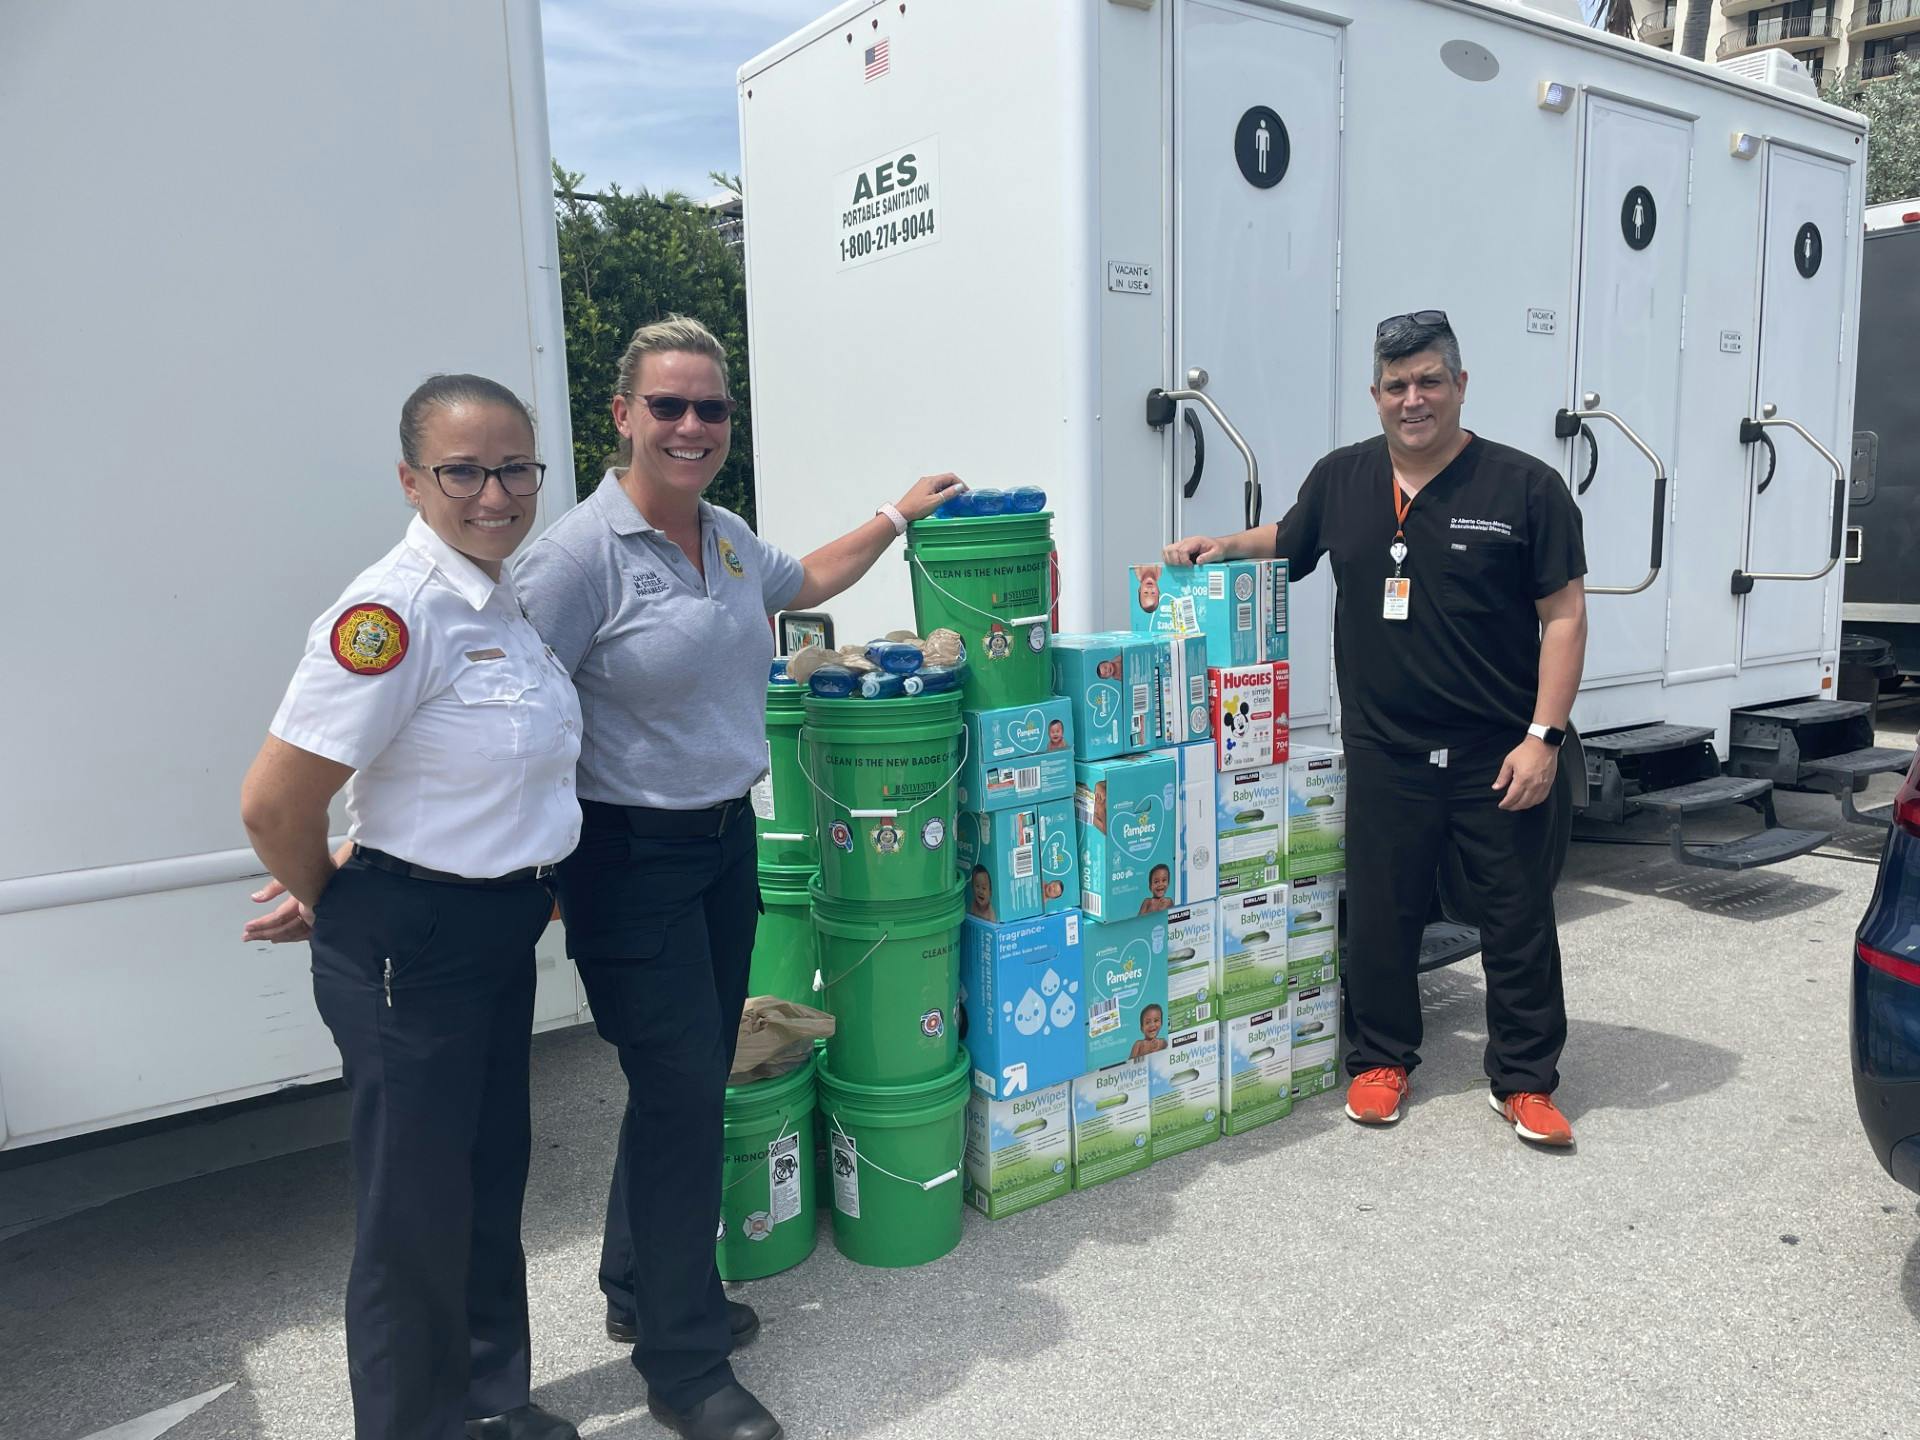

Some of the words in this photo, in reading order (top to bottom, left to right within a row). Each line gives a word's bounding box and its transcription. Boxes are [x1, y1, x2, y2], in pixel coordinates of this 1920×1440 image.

[852, 153, 918, 205] AES
[842, 200, 881, 229] PORTABLE
[882, 182, 930, 215] SANITATION
[840, 208, 935, 262] 1-800-274-9044
[1115, 265, 1142, 276] VACANT
[1115, 279, 1124, 288] IN
[1127, 280, 1143, 290] USE
[1532, 311, 1550, 320] VACANT
[633, 571, 657, 581] CAPTAIN
[933, 569, 961, 579] CLEAN
[964, 568, 972, 577] IS
[975, 568, 990, 578] THE
[993, 566, 1014, 576] NEW
[1017, 562, 1040, 574] BADGE
[636, 583, 669, 597] PARAMEDIC
[1223, 672, 1272, 689] HUGGIES
[1252, 687, 1271, 697] simply
[1017, 728, 1040, 738] Pampers
[826, 756, 851, 767] CLEAN
[855, 756, 863, 766] IS
[866, 757, 883, 767] THE
[886, 757, 910, 767] NEW
[912, 754, 941, 766] BADGE
[901, 781, 937, 793] SYLVESTER
[1306, 774, 1346, 788] BabyWipe
[1123, 823, 1156, 838] Pampers
[1111, 869, 1125, 881] 800
[1000, 943, 1017, 953] free
[984, 932, 995, 1035] fragrance-free
[1106, 968, 1142, 986] Pampers
